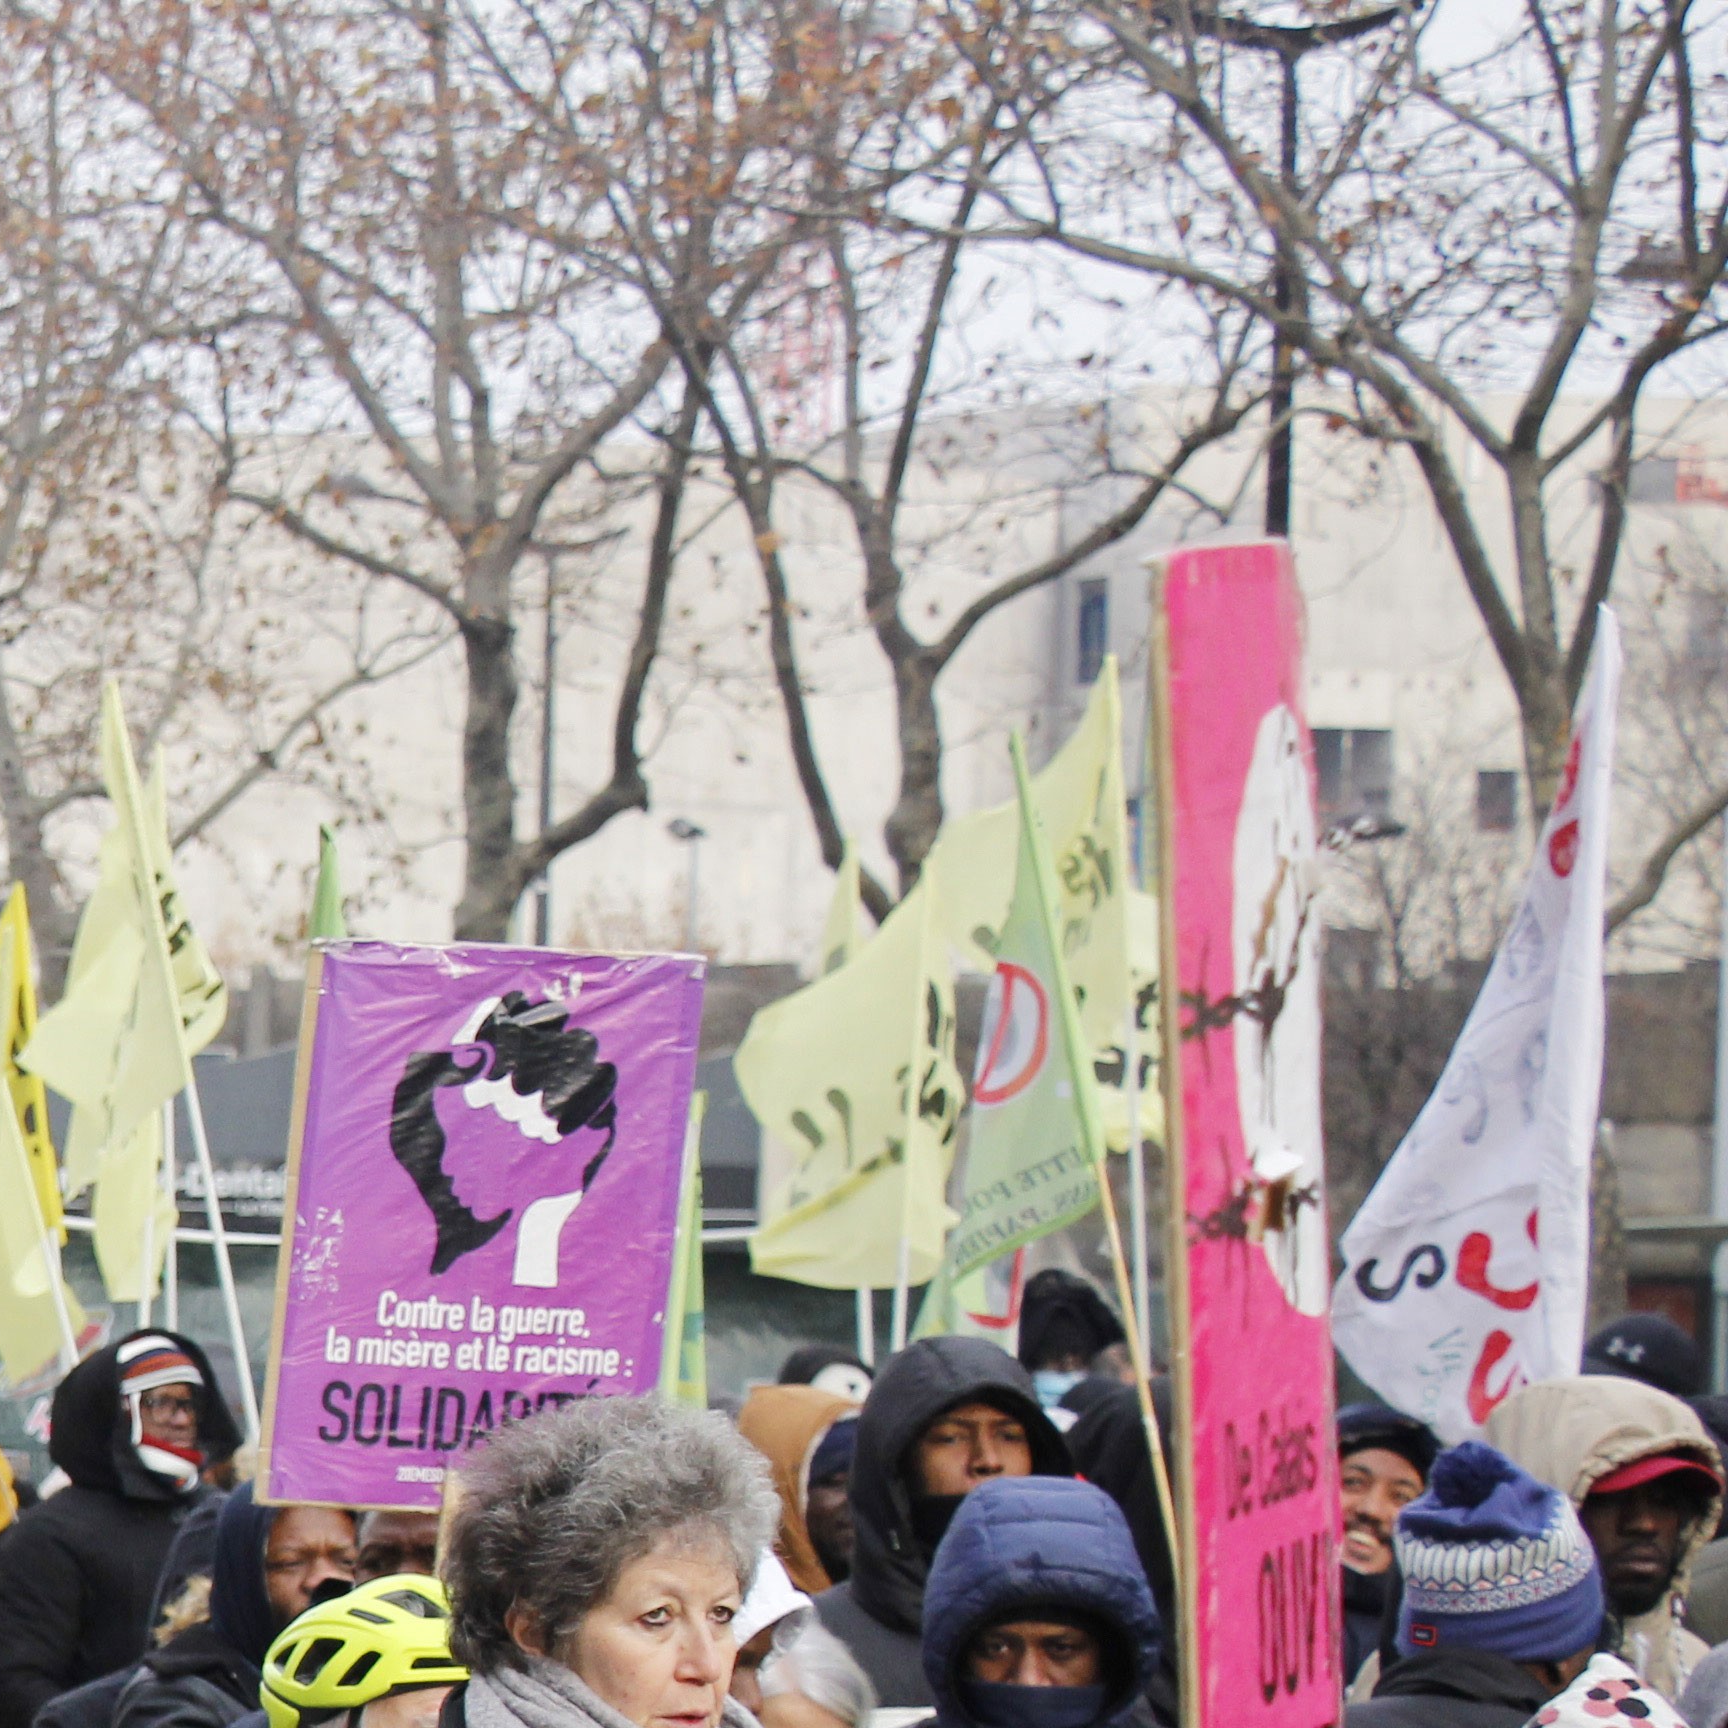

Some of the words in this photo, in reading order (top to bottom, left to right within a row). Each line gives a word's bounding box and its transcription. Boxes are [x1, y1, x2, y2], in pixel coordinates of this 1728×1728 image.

[377, 1290, 466, 1331] Contre
[470, 1295, 494, 1333] la
[325, 1326, 351, 1364] la
[356, 1330, 450, 1369] misère
[455, 1338, 483, 1371] et
[485, 1336, 510, 1372] le
[513, 1338, 621, 1377] racisme
[1225, 1421, 1252, 1520] De
